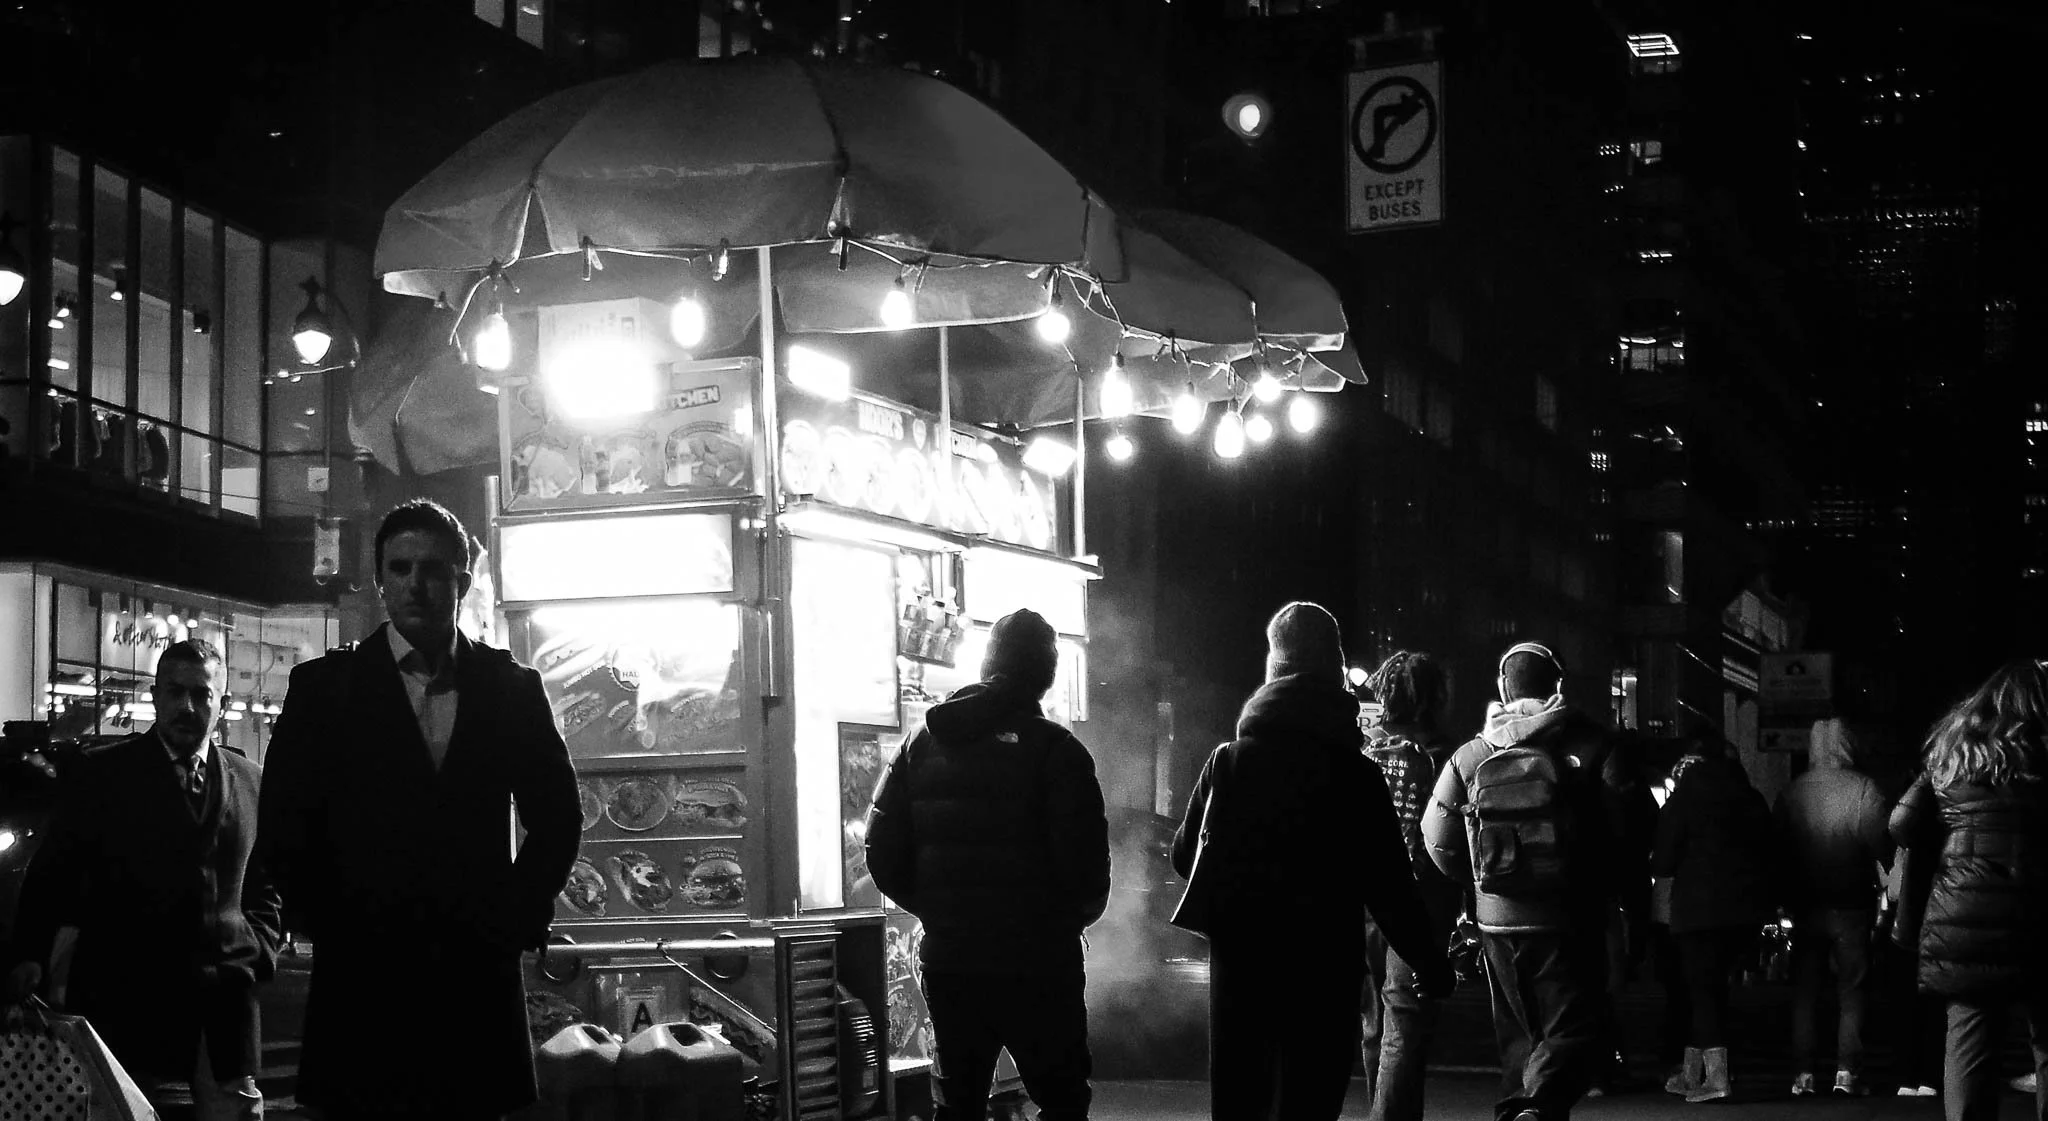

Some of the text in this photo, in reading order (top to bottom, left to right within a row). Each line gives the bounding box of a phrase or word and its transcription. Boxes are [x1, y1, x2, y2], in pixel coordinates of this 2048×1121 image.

[1364, 179, 1425, 201] EXCEPT
[1368, 201, 1422, 221] BUSES
[630, 1002, 654, 1033] A
